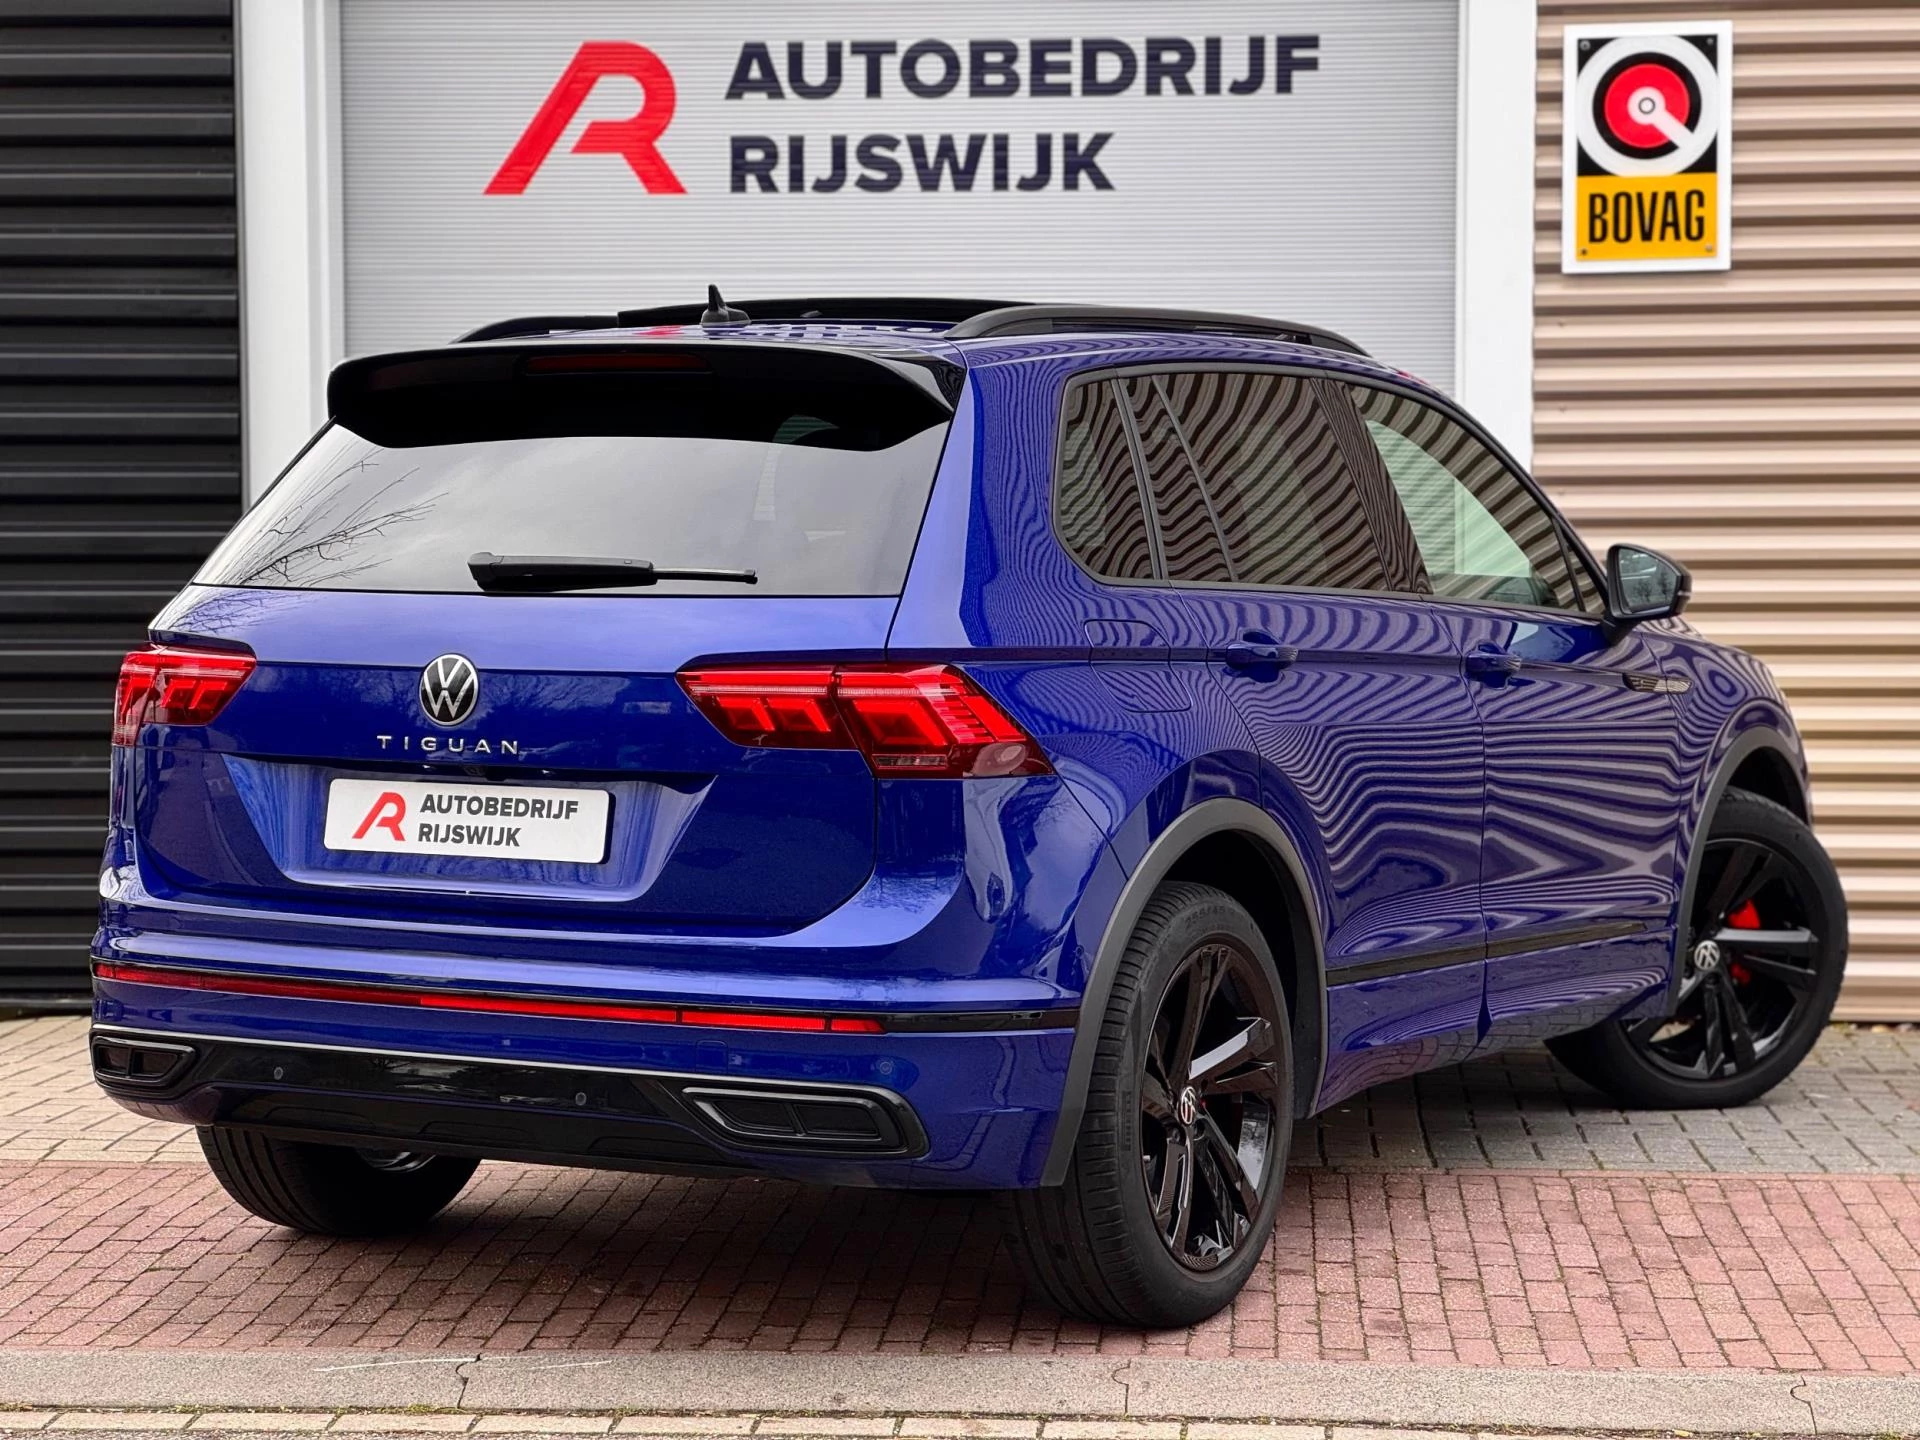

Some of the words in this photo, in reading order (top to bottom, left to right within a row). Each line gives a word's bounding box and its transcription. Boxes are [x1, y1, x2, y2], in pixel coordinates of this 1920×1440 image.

[725, 35, 1320, 100] AUTOBEDRIJF
[730, 132, 1115, 193] RIJSWIJK
[1588, 189, 1705, 243] BOVAG
[376, 735, 518, 754] TIGUAN
[420, 793, 579, 820] AUTOBEDRIJF
[418, 823, 521, 847] RIJSWIJK
